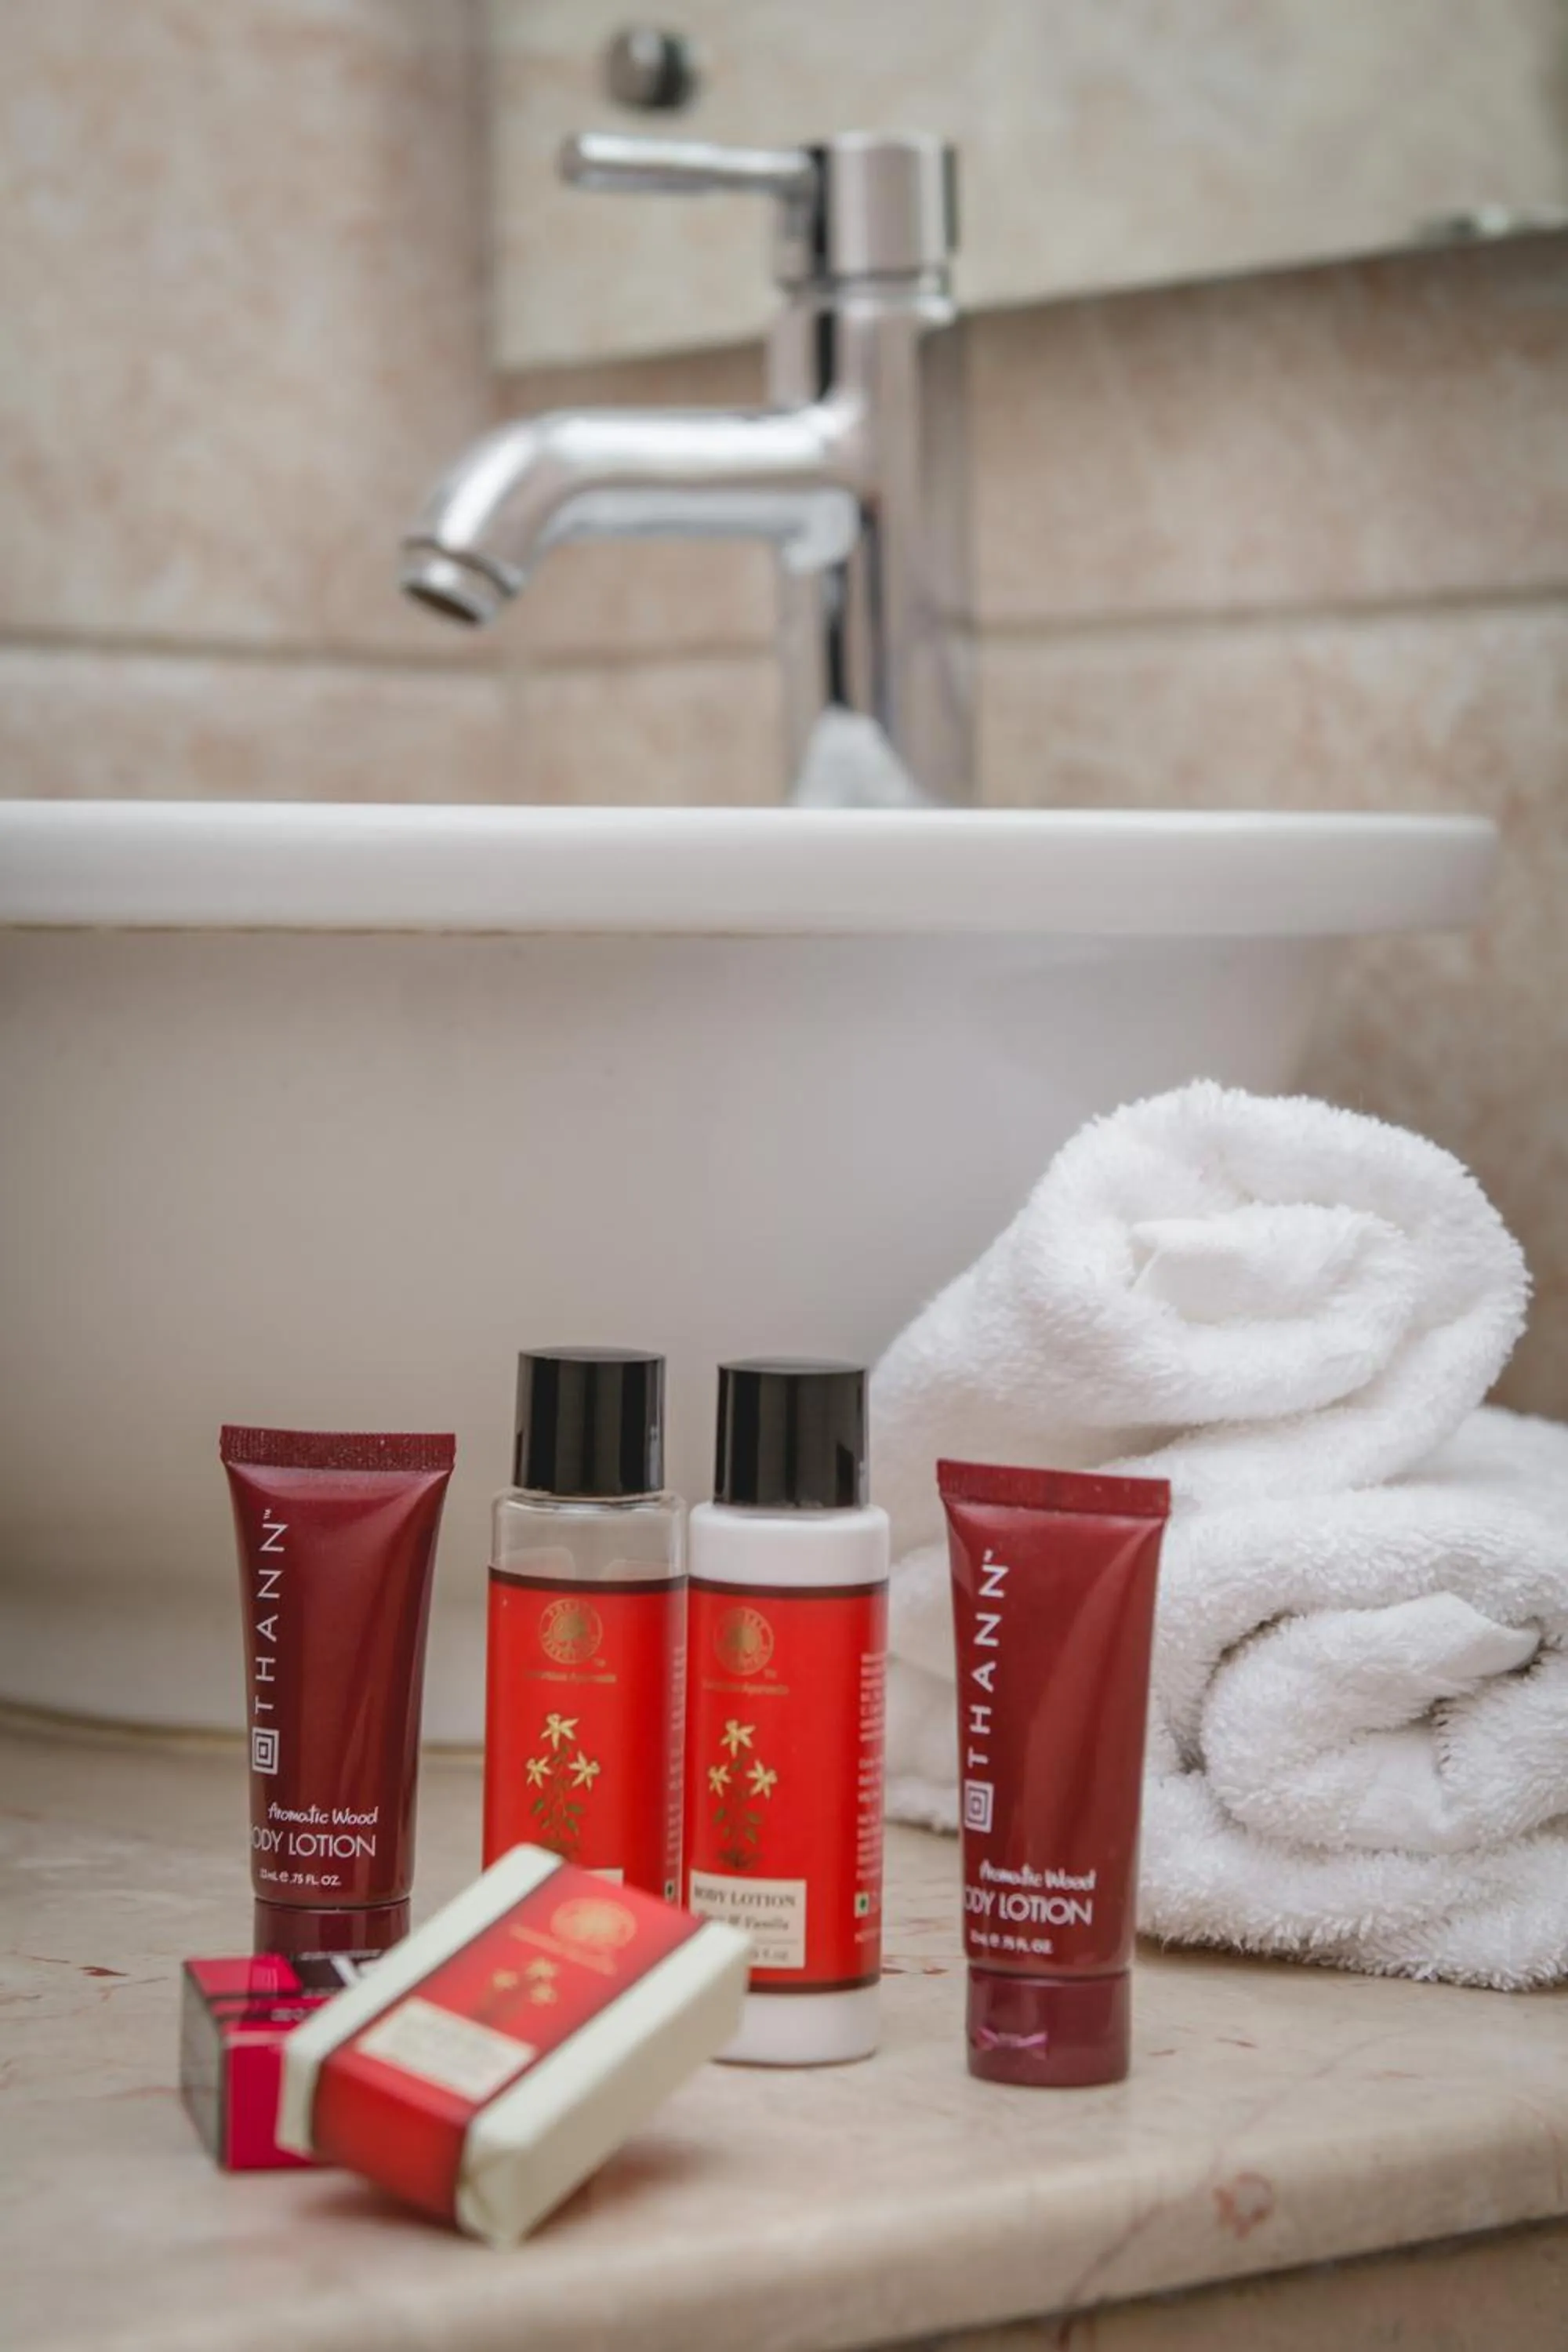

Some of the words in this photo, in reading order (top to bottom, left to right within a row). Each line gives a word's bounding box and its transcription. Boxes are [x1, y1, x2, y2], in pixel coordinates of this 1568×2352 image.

[267, 1802, 328, 1825] Aromatic
[332, 1806, 379, 1825] Wood
[252, 1826, 284, 1853] ODY
[288, 1831, 376, 1858] LOTION
[730, 1889, 797, 1907] LOTION
[964, 1884, 995, 1917] ODY
[998, 1892, 1093, 1926] LOTION
